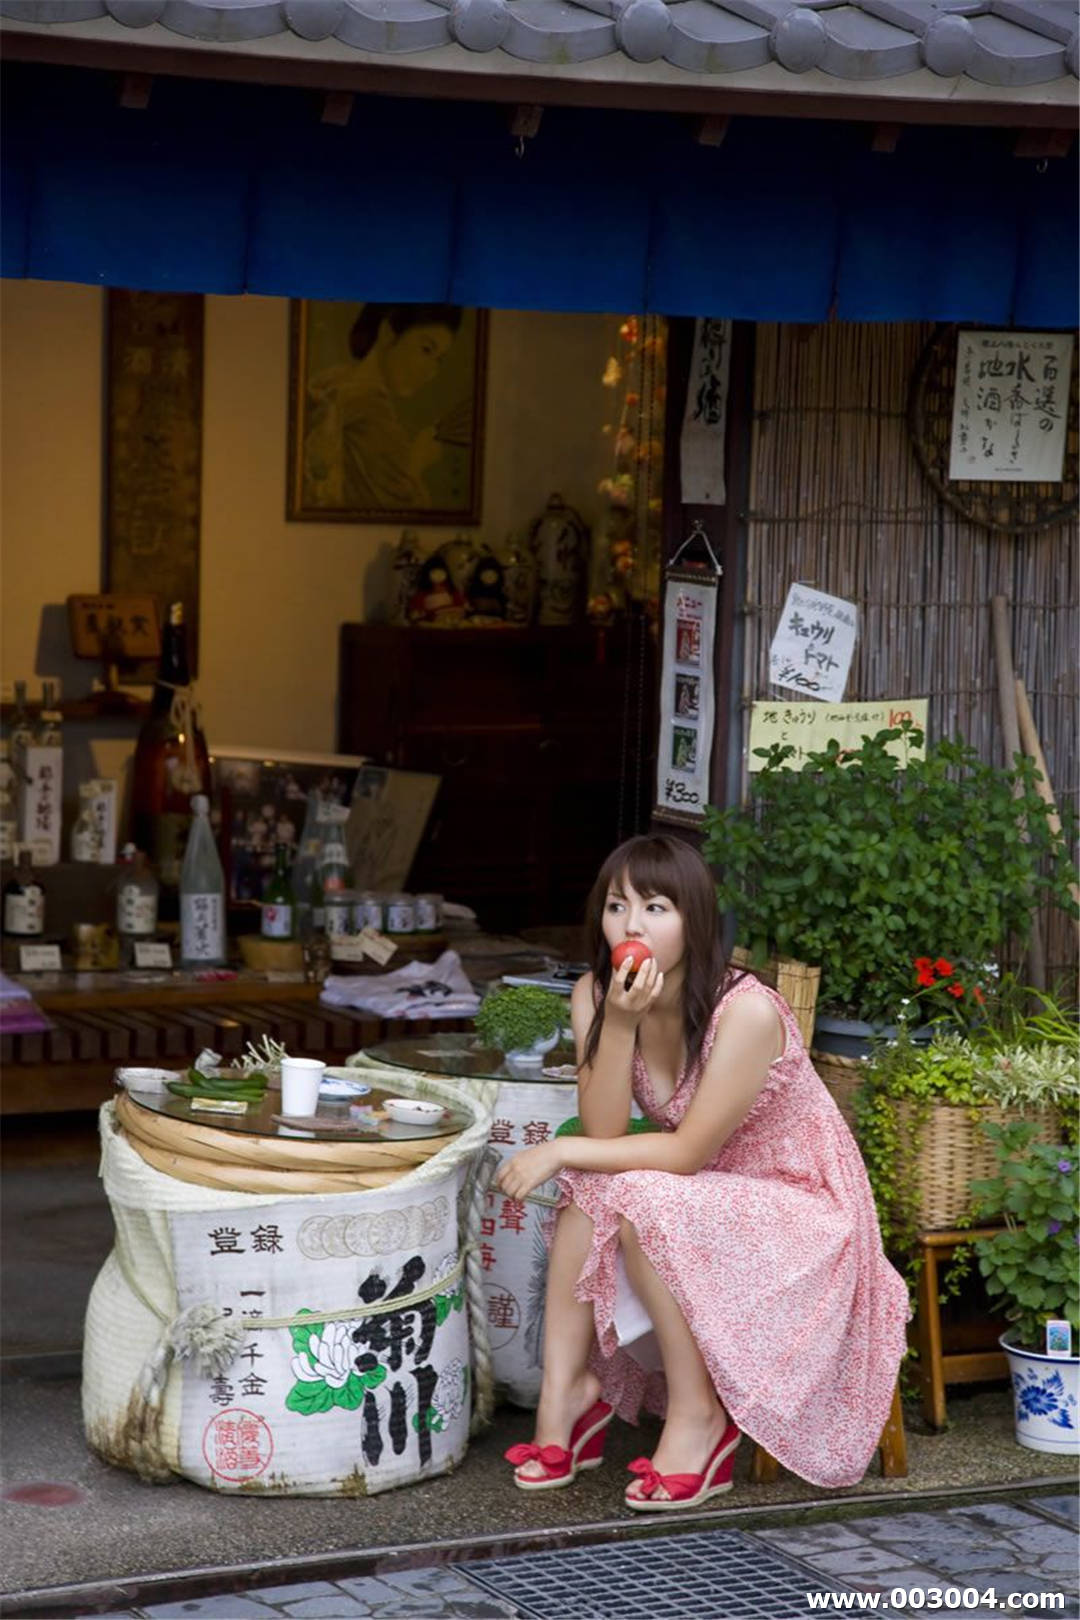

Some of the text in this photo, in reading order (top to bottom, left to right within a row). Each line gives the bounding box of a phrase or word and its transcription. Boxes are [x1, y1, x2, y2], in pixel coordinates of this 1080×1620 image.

[1034, 355, 1061, 432] 百選の
[788, 611, 836, 645] キュウリ
[804, 648, 840, 672] トマト
[664, 778, 699, 804] ¥300
[488, 1118, 552, 1146] 登録
[208, 1224, 284, 1256] 登録
